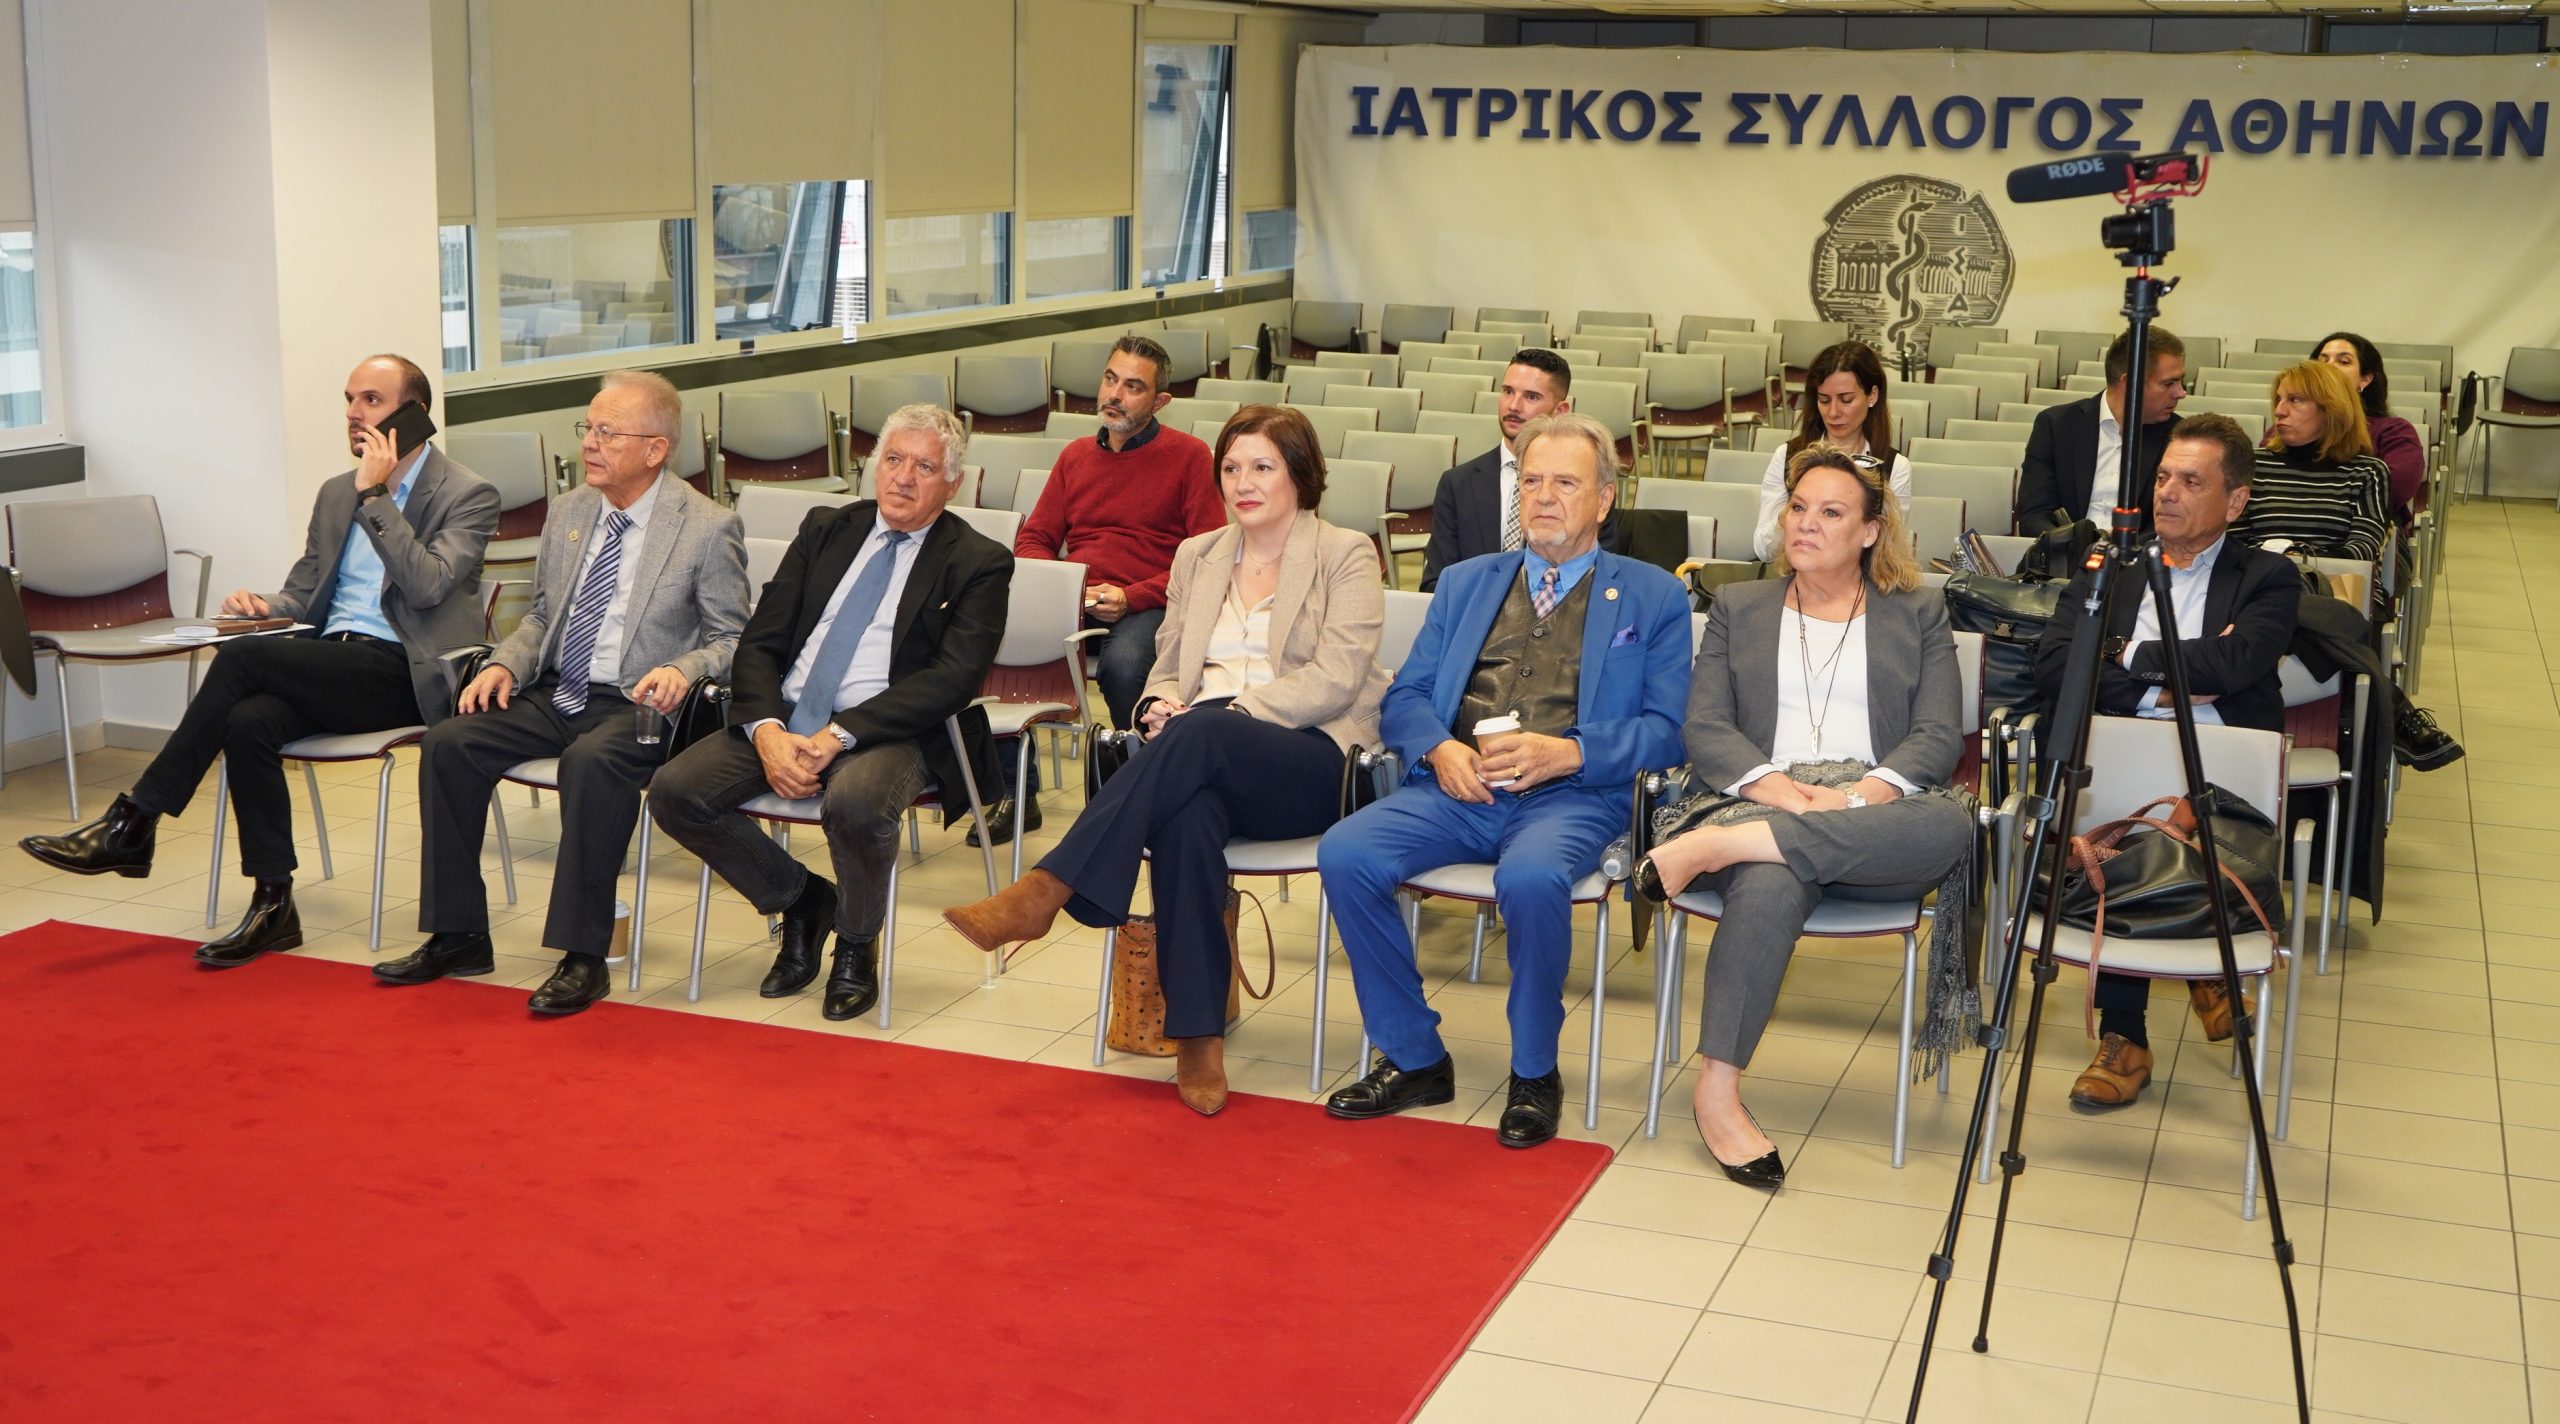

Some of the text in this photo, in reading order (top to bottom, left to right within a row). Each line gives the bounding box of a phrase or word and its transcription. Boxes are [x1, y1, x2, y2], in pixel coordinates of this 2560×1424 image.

[1351, 85, 2550, 158] ΙΑΤΡΙΚΟΣ ΣΥΛΛΟΓΟΣ ΑΘΗΝΩΝ
